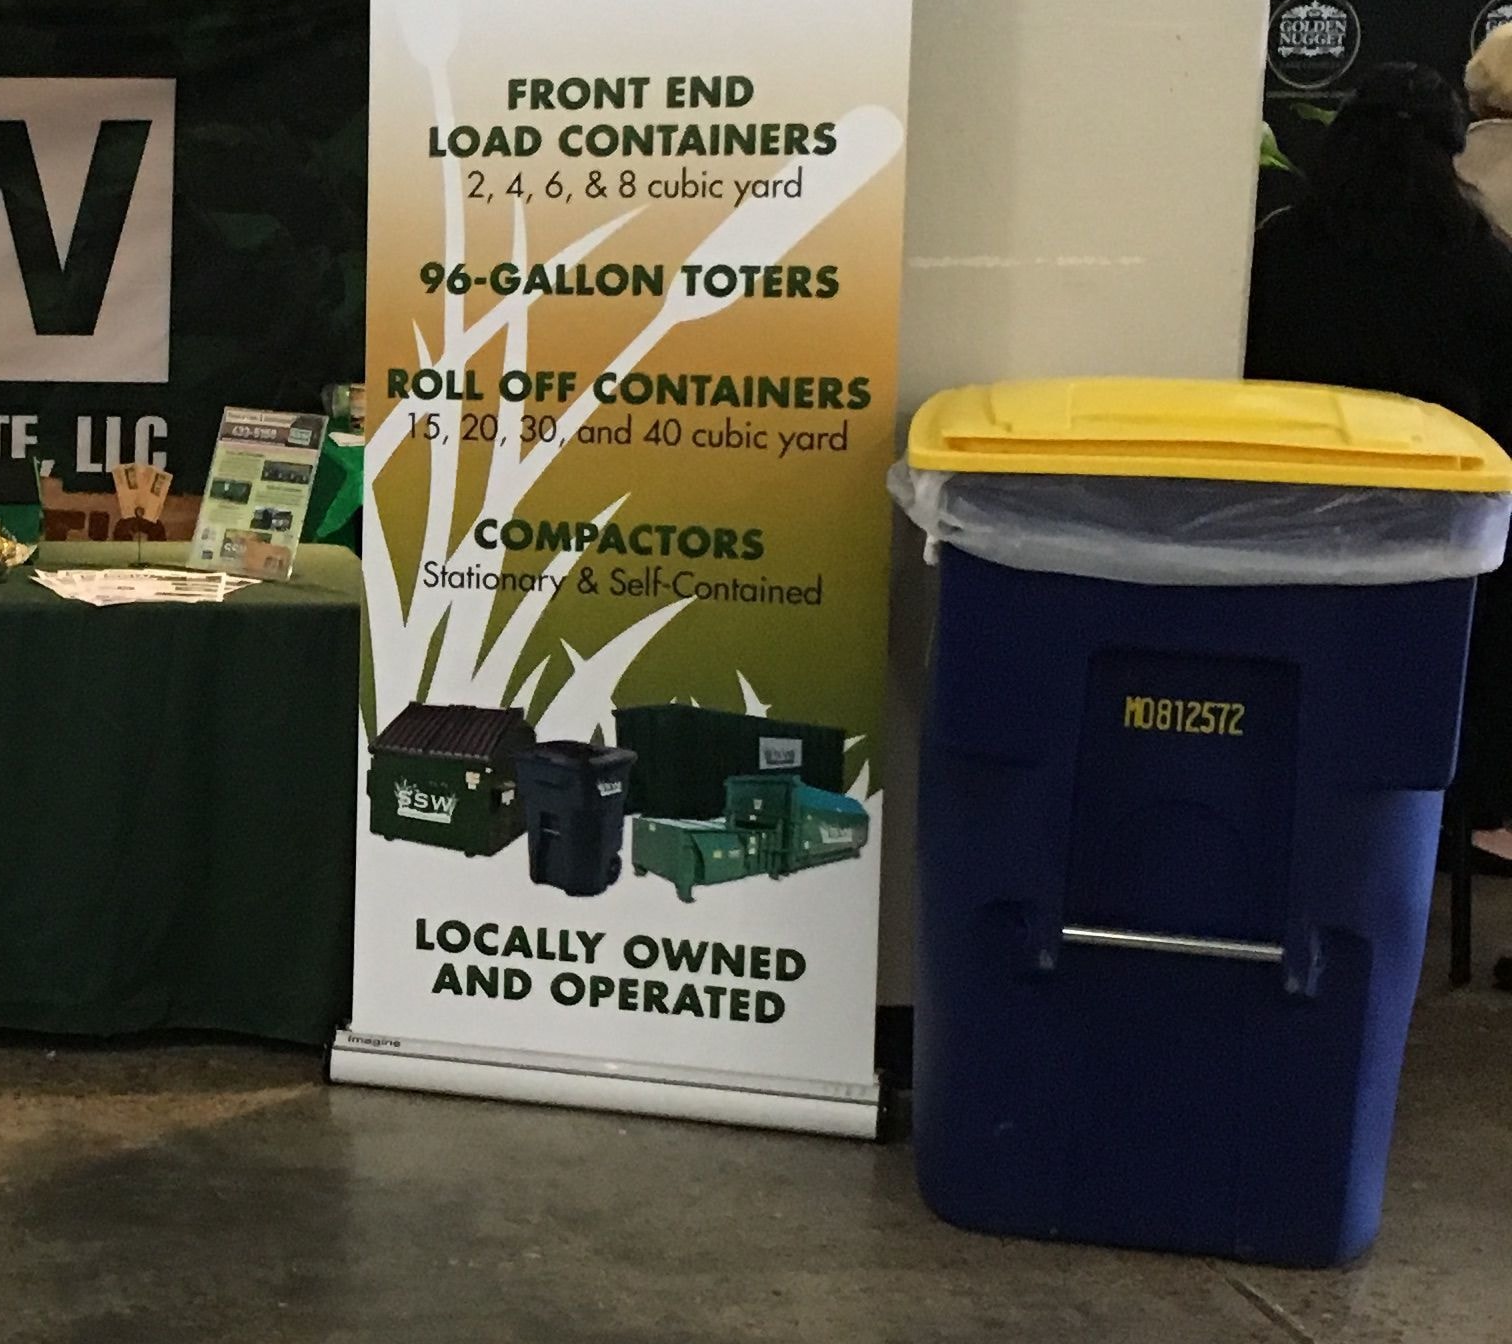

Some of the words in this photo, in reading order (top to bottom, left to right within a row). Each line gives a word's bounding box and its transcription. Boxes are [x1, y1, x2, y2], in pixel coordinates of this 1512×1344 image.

[1279, 20, 1346, 34] GOLDEN
[1279, 32, 1344, 46] NUGGET
[507, 77, 650, 112] FRONT
[666, 76, 754, 109] END
[429, 126, 543, 158] LOAD
[558, 121, 838, 157] CONTAINERS
[467, 170, 494, 203] 2,
[506, 170, 533, 204] 4,
[544, 170, 573, 204] 6,
[584, 170, 607, 199] &
[619, 170, 637, 199] 8
[647, 167, 724, 200] cubic
[733, 166, 803, 208] yard
[419, 261, 664, 296] 96-GALLON
[680, 264, 840, 299] TOTERS
[387, 368, 483, 402] ROLL
[499, 369, 577, 403] OFF
[592, 372, 872, 411] CONTAINERS
[408, 412, 449, 445] 15,
[461, 413, 506, 446] 20,
[520, 414, 565, 448] 30,
[577, 413, 632, 446] and
[643, 417, 682, 447] 40
[691, 418, 768, 450] cubic
[778, 419, 849, 458] yard
[474, 518, 765, 561] COMPACTORS
[422, 560, 567, 598] Stationary
[577, 567, 599, 597] &
[610, 565, 823, 606] Self-Contained
[415, 917, 606, 964] LOCALLY
[623, 934, 807, 983] OWNED
[431, 963, 532, 1000] AND
[550, 971, 786, 1024] OPERATED
